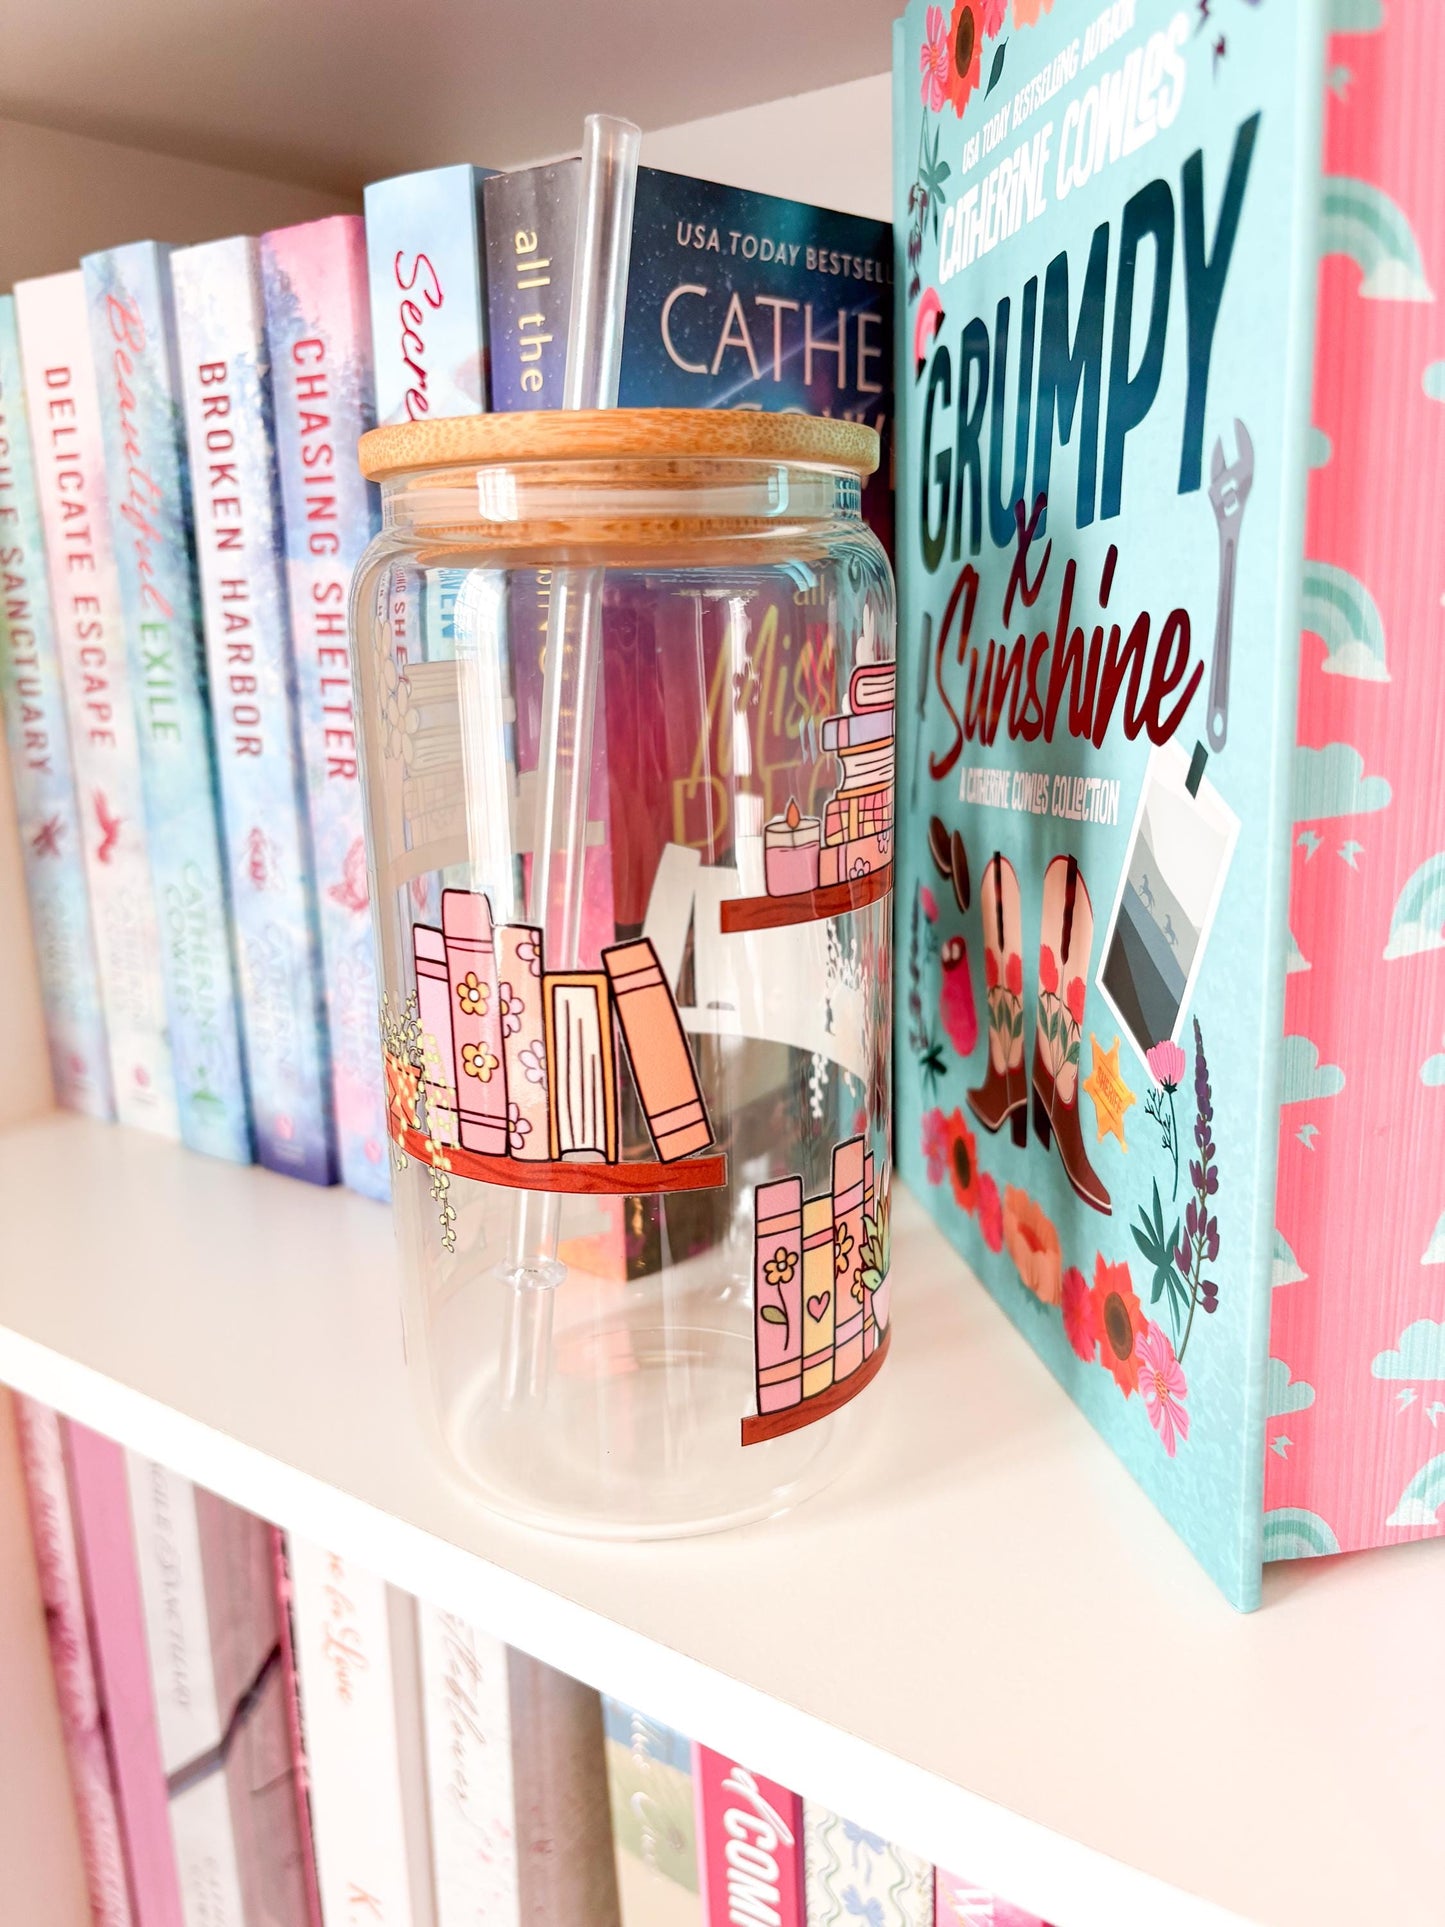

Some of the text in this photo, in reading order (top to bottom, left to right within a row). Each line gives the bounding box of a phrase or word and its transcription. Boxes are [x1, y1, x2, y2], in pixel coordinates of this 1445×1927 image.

[939, 121, 1053, 284] CATHERINE
[962, 131, 981, 175] USA
[981, 100, 1011, 159] TODAY
[514, 230, 553, 393] all the
[676, 221, 720, 252] USA
[729, 231, 801, 267] TODAY
[661, 284, 883, 394] CATHE
[919, 110, 1262, 575] GRUMPY
[44, 366, 117, 751] DELICATE ESCAPE
[104, 292, 183, 745] Beautiful EXILE
[198, 360, 263, 758] BROKEN HARBOR
[291, 337, 358, 783] CHASING SHELTER
[928, 544, 1204, 782] Sunshine
[967, 768, 1010, 809] CATHERINE
[723, 1808, 782, 1927] COM
